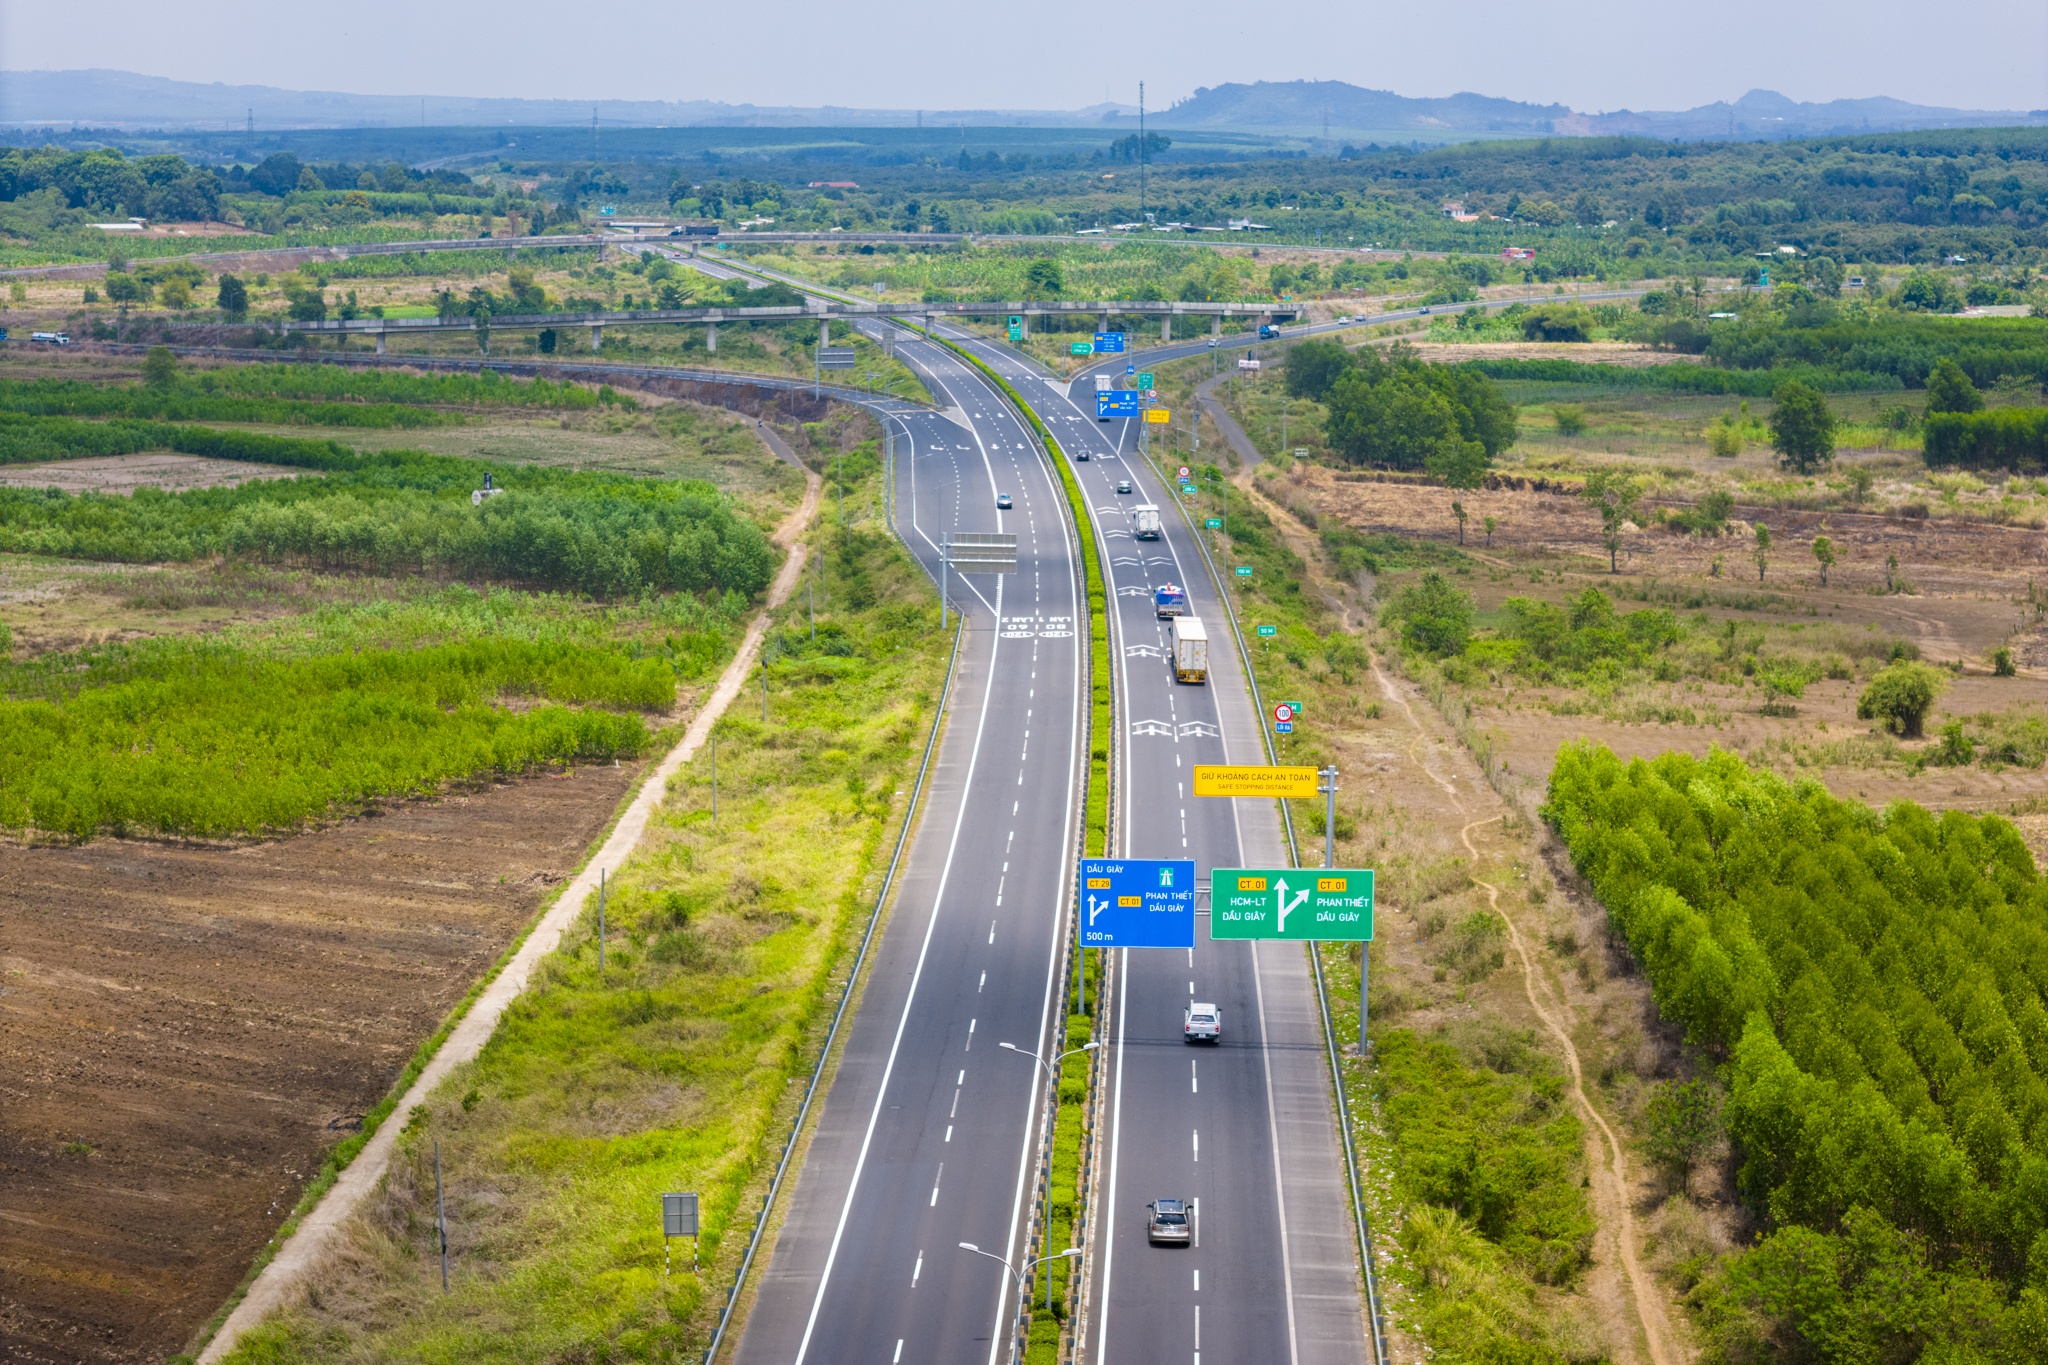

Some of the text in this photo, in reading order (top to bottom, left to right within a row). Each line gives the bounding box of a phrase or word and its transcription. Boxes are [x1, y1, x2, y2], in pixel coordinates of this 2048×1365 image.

[1279, 709, 1289, 717] 100
[1145, 889, 1193, 900] PHAN THIẾT
[1230, 897, 1267, 907] HCM-LT
[1317, 895, 1370, 907] PHAN THIẾT
[1086, 932, 1103, 941] 500
